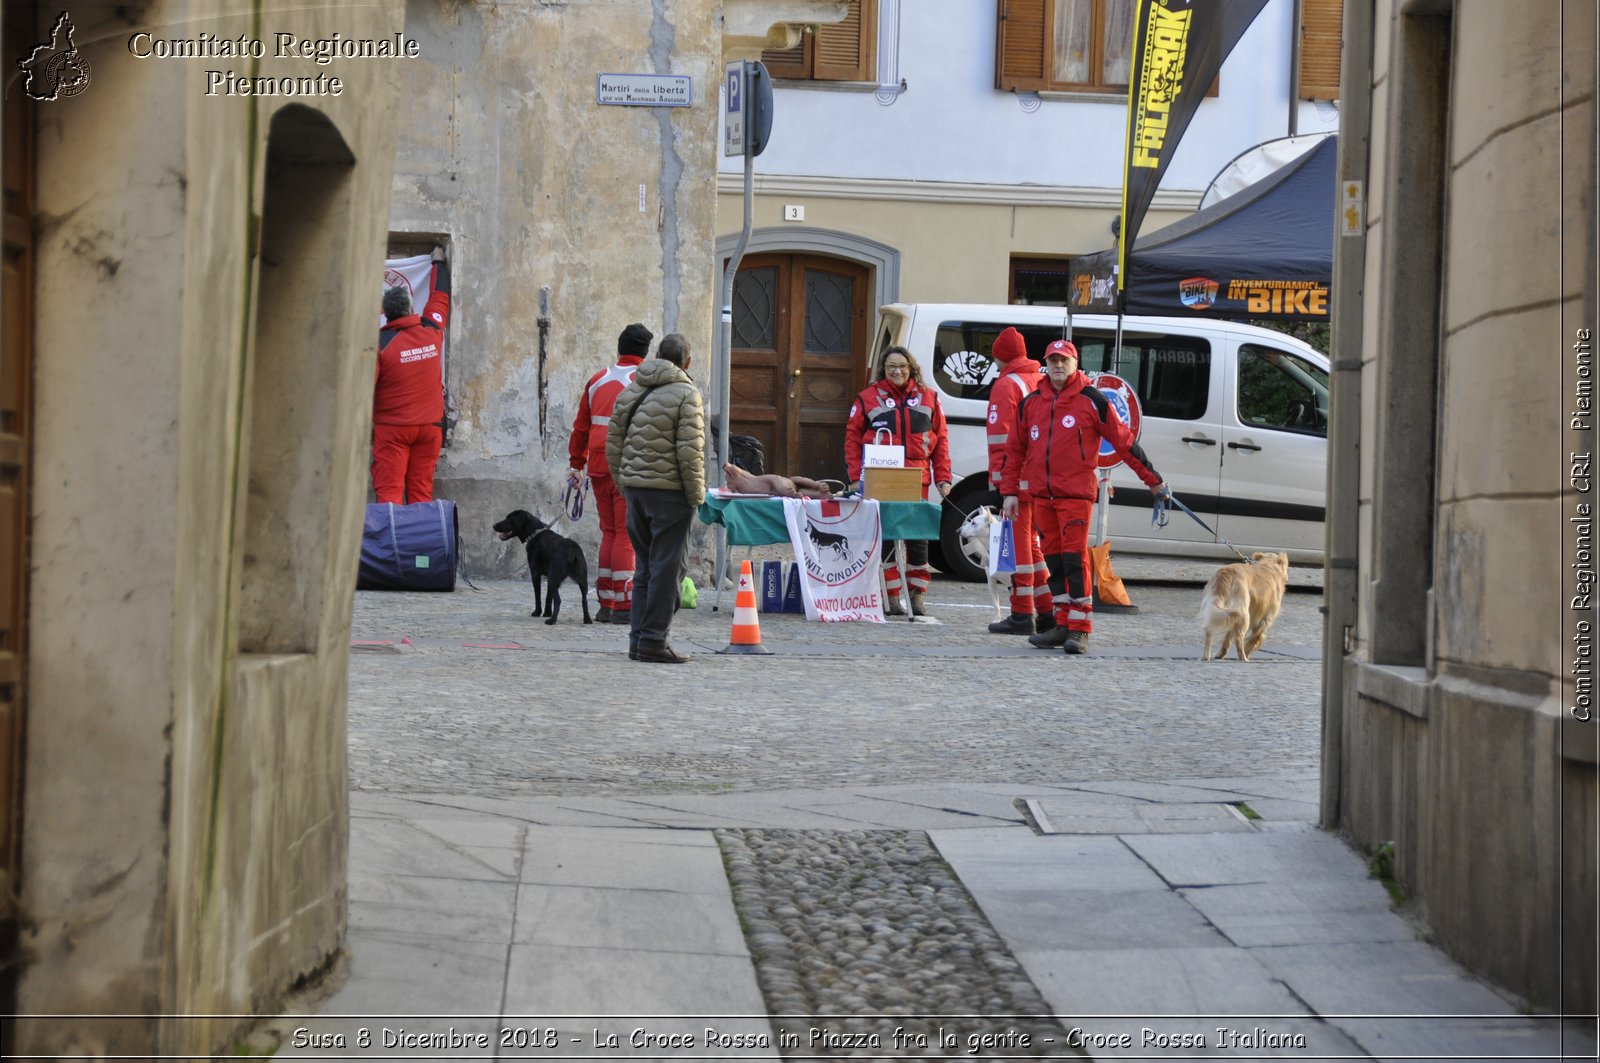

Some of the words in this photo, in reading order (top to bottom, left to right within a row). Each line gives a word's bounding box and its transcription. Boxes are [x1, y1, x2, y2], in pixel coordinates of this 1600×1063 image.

[601, 83, 630, 93] Martiri
[730, 75, 739, 108] P
[792, 208, 798, 218] 3
[1227, 287, 1246, 300] IN
[1248, 288, 1328, 315] BIKE
[826, 550, 870, 583] CINOFILA
[840, 594, 878, 611] LOCALE
